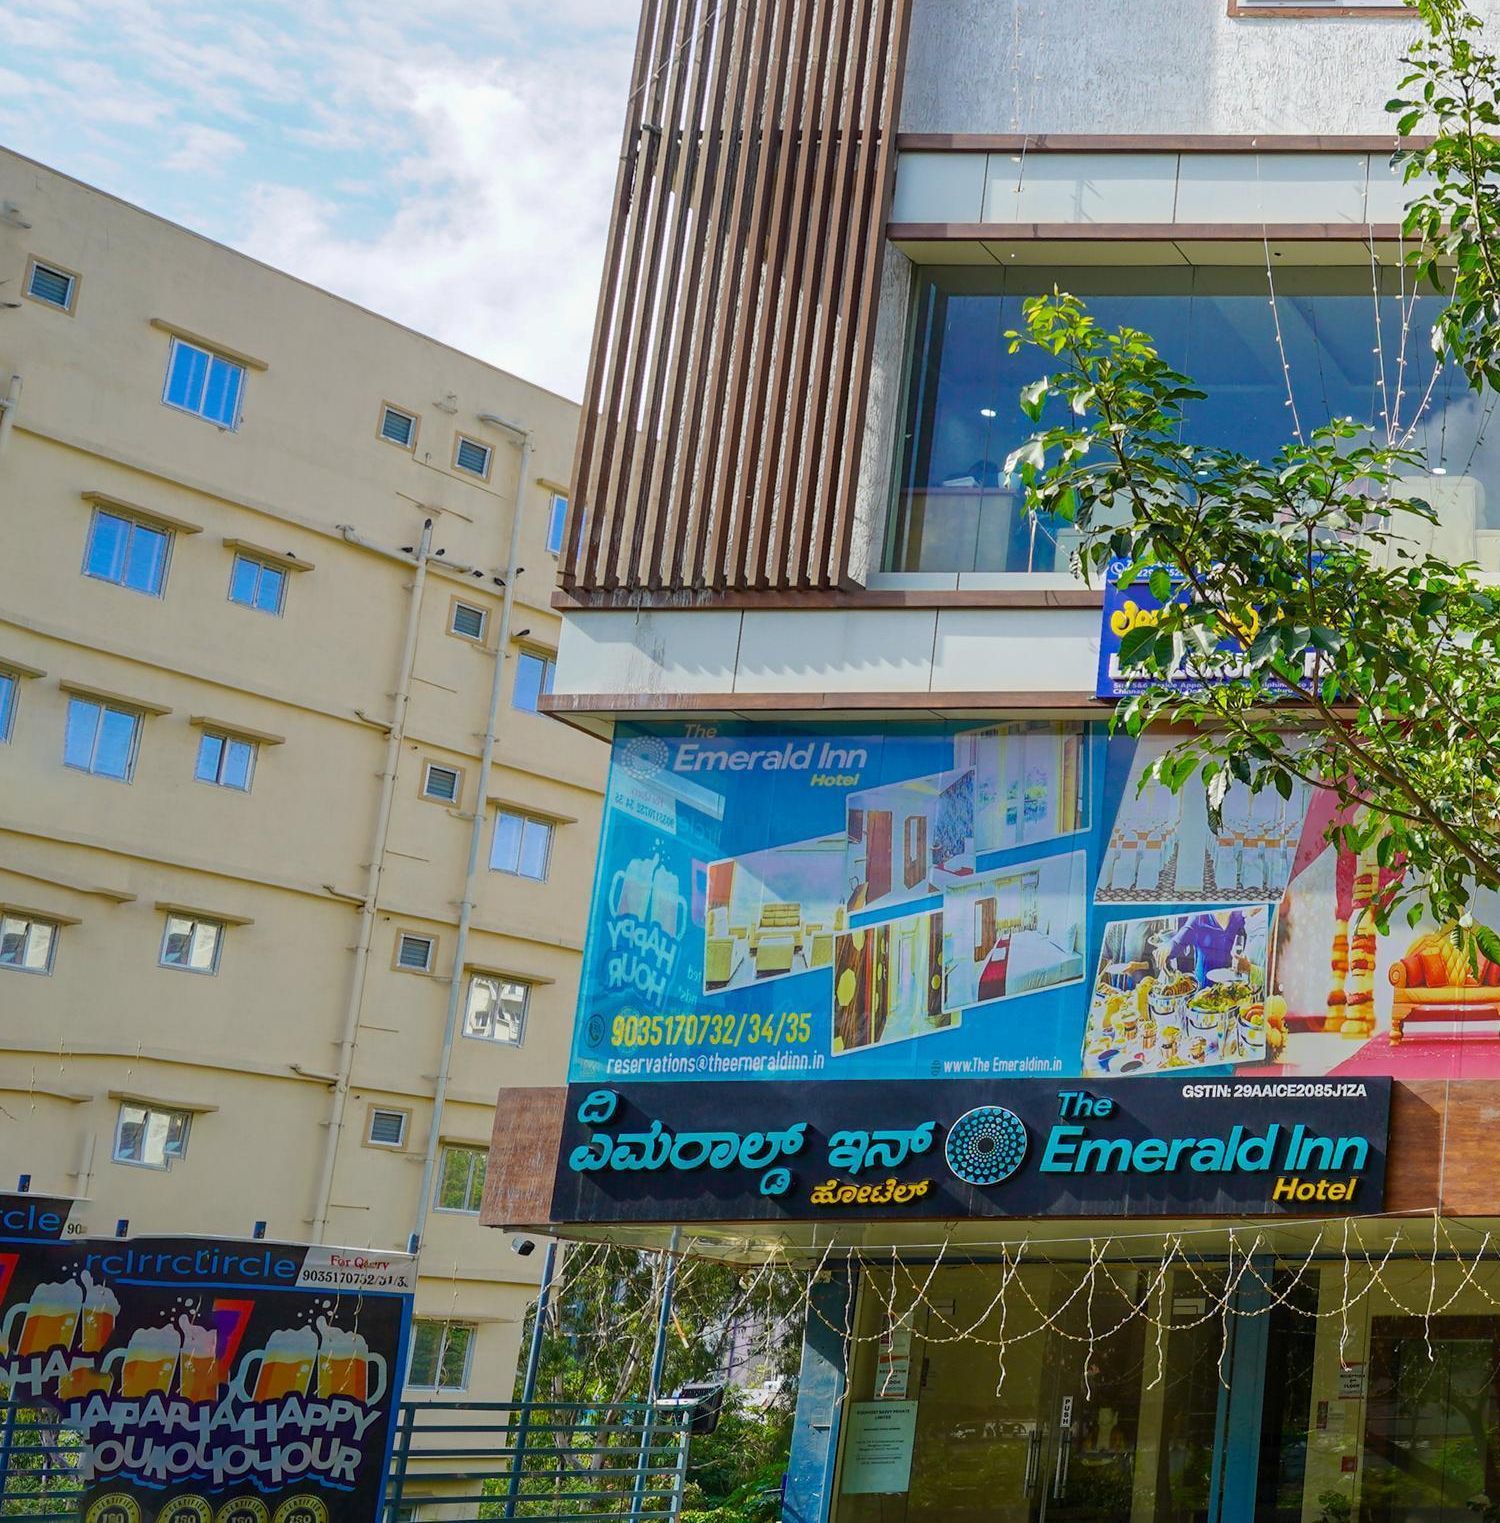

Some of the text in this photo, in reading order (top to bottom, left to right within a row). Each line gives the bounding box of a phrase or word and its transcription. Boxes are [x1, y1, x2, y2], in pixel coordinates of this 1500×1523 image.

[684, 724, 717, 739] The
[673, 742, 868, 772] Emerald Inn
[810, 773, 860, 787] Hotel
[611, 1012, 811, 1047] 9035170732/34/35
[606, 1050, 825, 1074] reservations@theemeraldinn.in
[1058, 1091, 1113, 1118] The
[1182, 1084, 1367, 1098] GSTIN: 29AAICE2085J1ZA
[577, 1089, 618, 1124] ದಿ
[827, 1121, 936, 1175] ಇನ್
[1039, 1123, 1369, 1173] Emerald Inn
[1272, 1177, 1358, 1201] Hotel
[331, 1255, 351, 1268] For
[1062, 1398, 1071, 1425] PUSH
